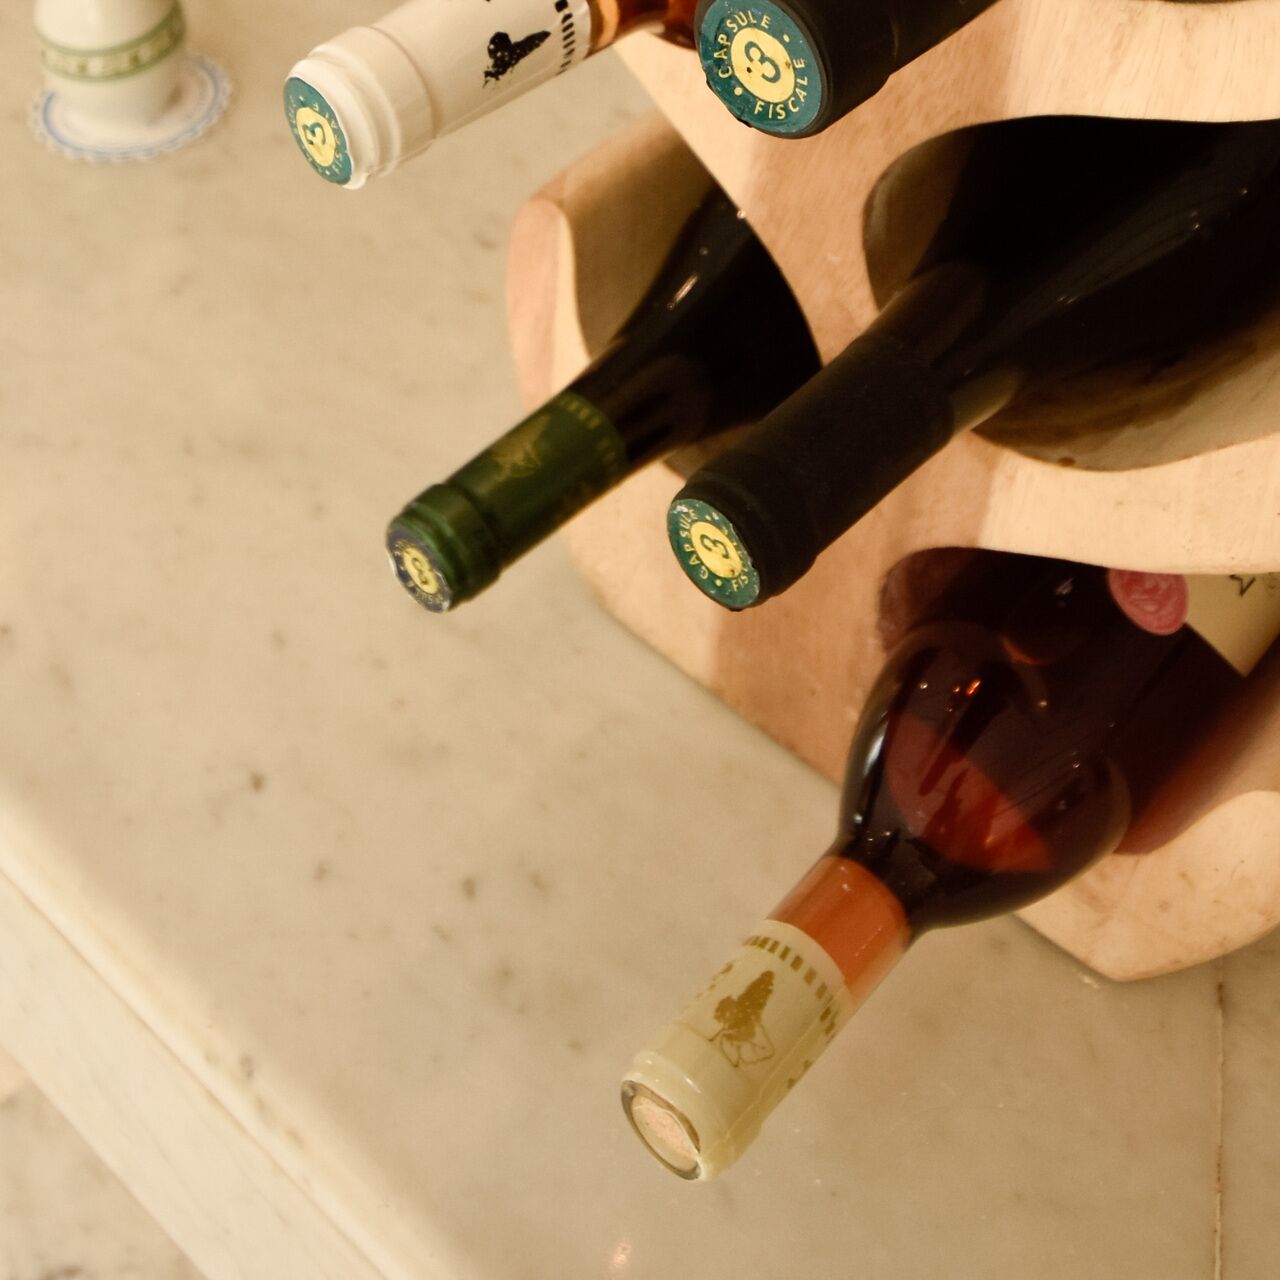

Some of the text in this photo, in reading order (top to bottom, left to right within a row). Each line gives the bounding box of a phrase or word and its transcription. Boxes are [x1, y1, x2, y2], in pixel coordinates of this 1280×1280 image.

[713, 10, 808, 120] CAPSULE FISCALE
[744, 40, 781, 84] 3
[302, 121, 327, 146] 3
[679, 509, 709, 580] CAPSULE
[700, 533, 731, 559] 3
